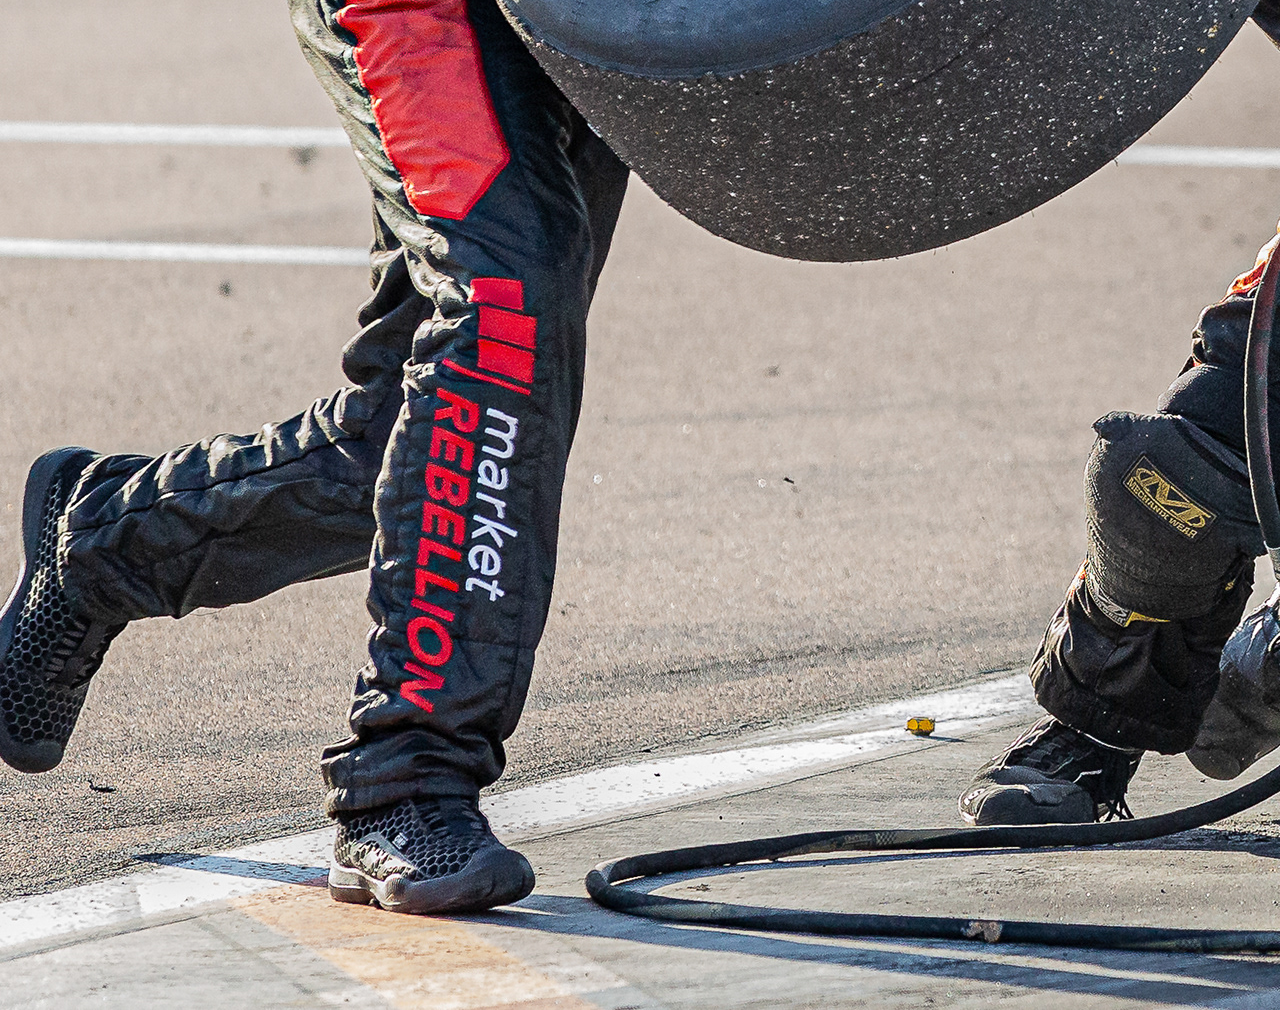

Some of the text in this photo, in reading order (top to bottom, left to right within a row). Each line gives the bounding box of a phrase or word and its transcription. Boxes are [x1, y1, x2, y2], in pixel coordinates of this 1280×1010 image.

[399, 386, 480, 714] REBELLION
[464, 406, 520, 602] market
[1168, 518, 1198, 539] WEAR
